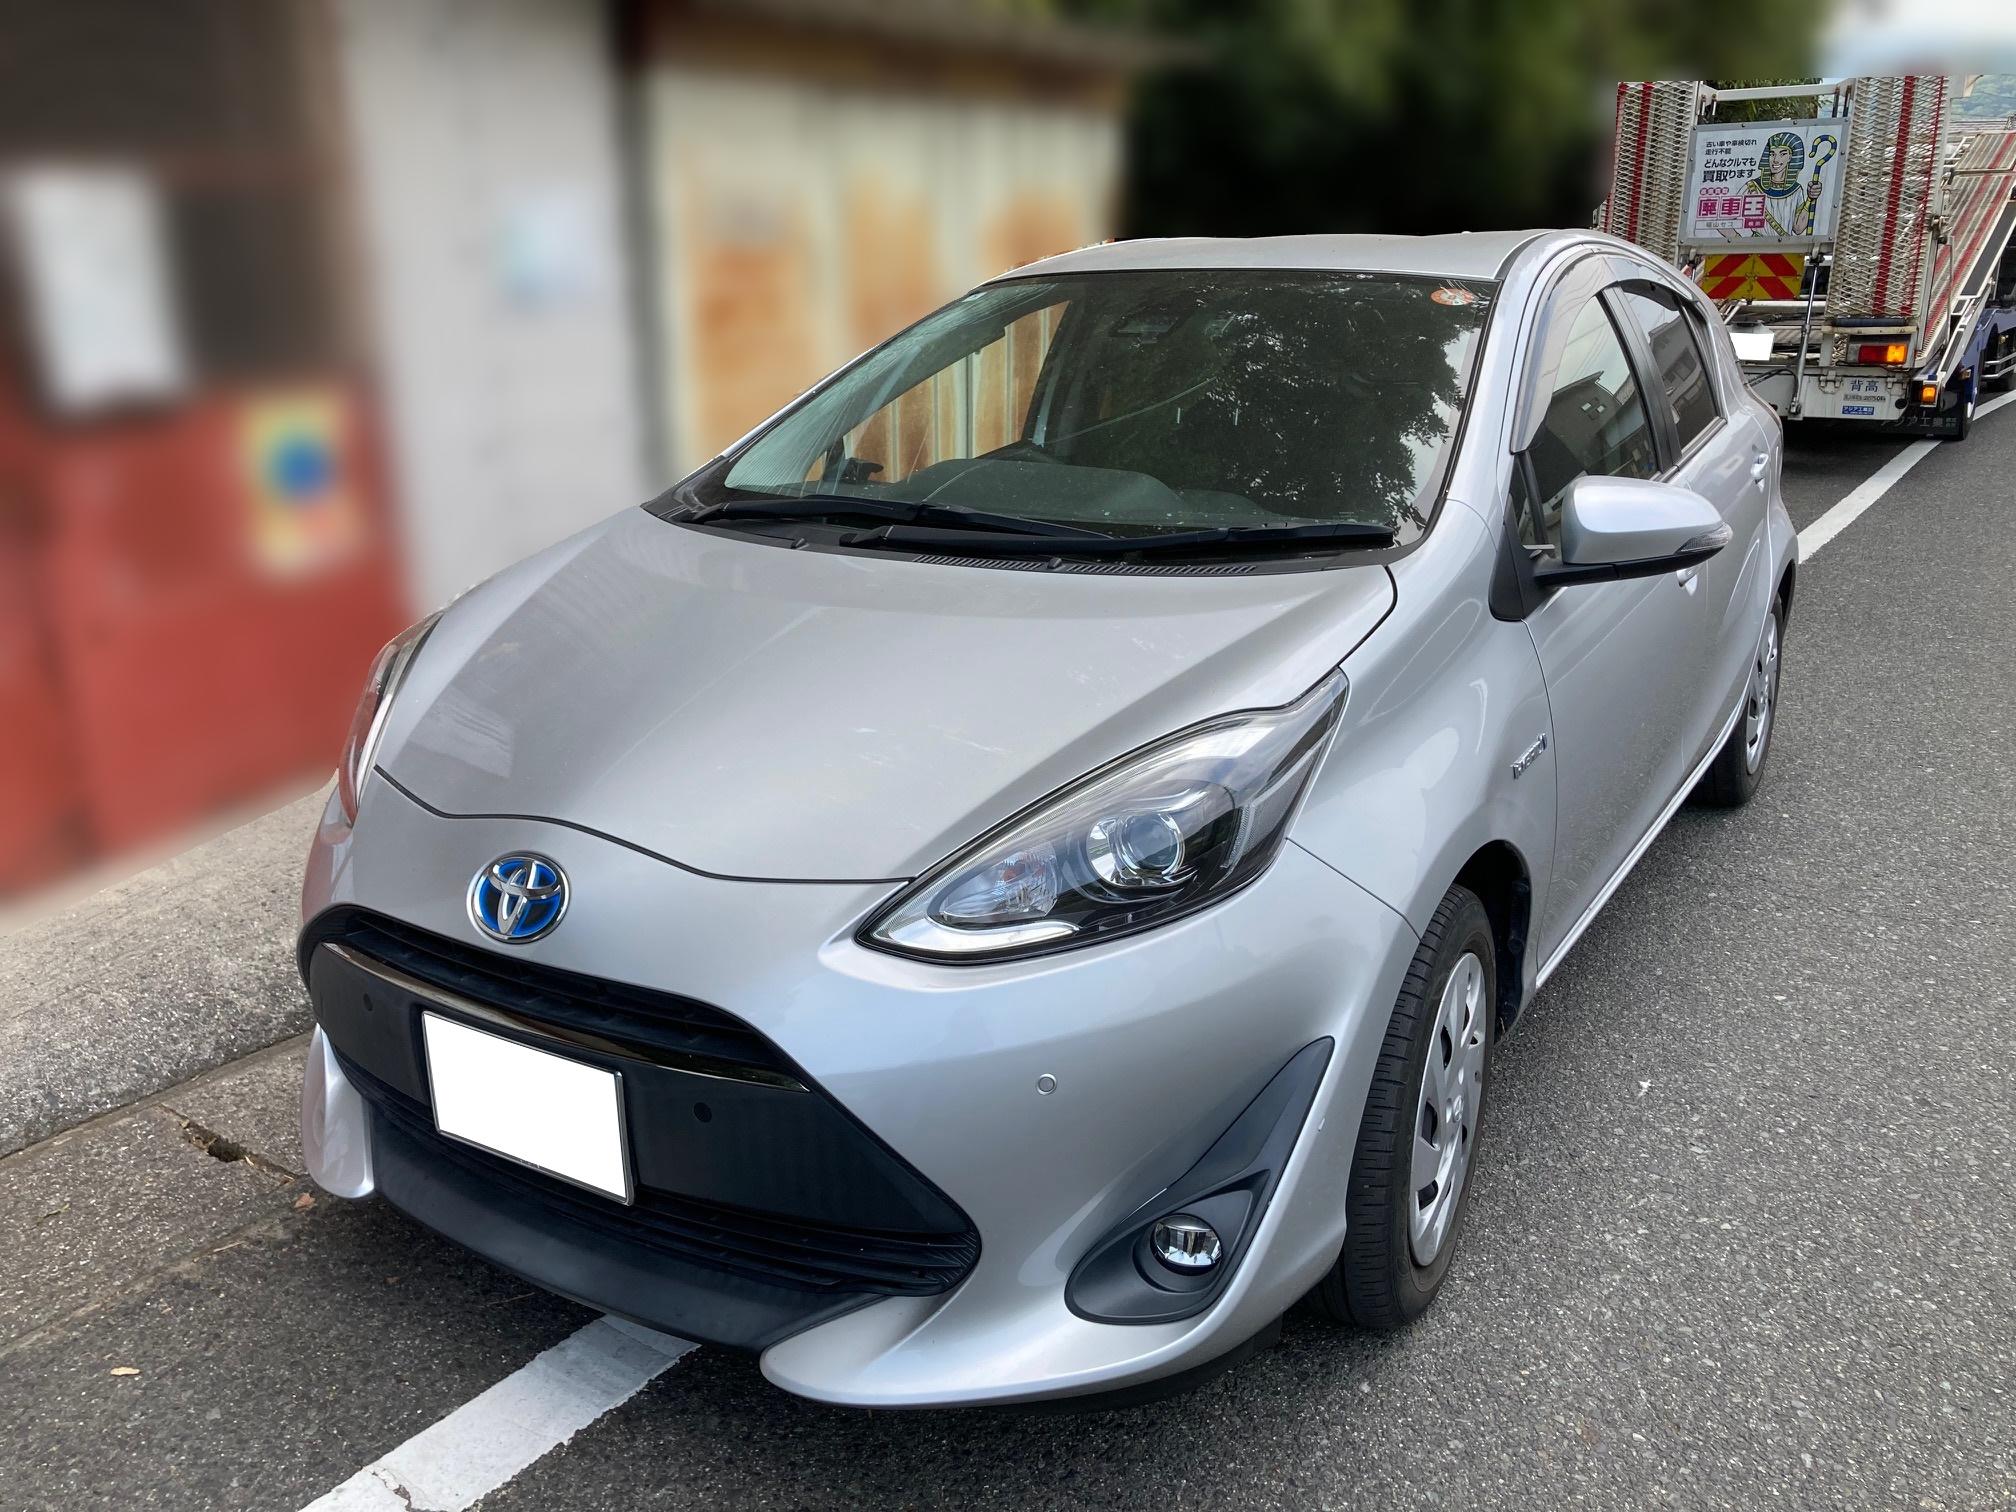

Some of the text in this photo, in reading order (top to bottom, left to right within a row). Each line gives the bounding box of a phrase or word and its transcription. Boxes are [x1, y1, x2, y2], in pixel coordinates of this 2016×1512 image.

[1704, 157, 1757, 168] どんなクルマも
[1702, 169, 1756, 183] 買取ります
[1850, 379, 1880, 393] 背高
